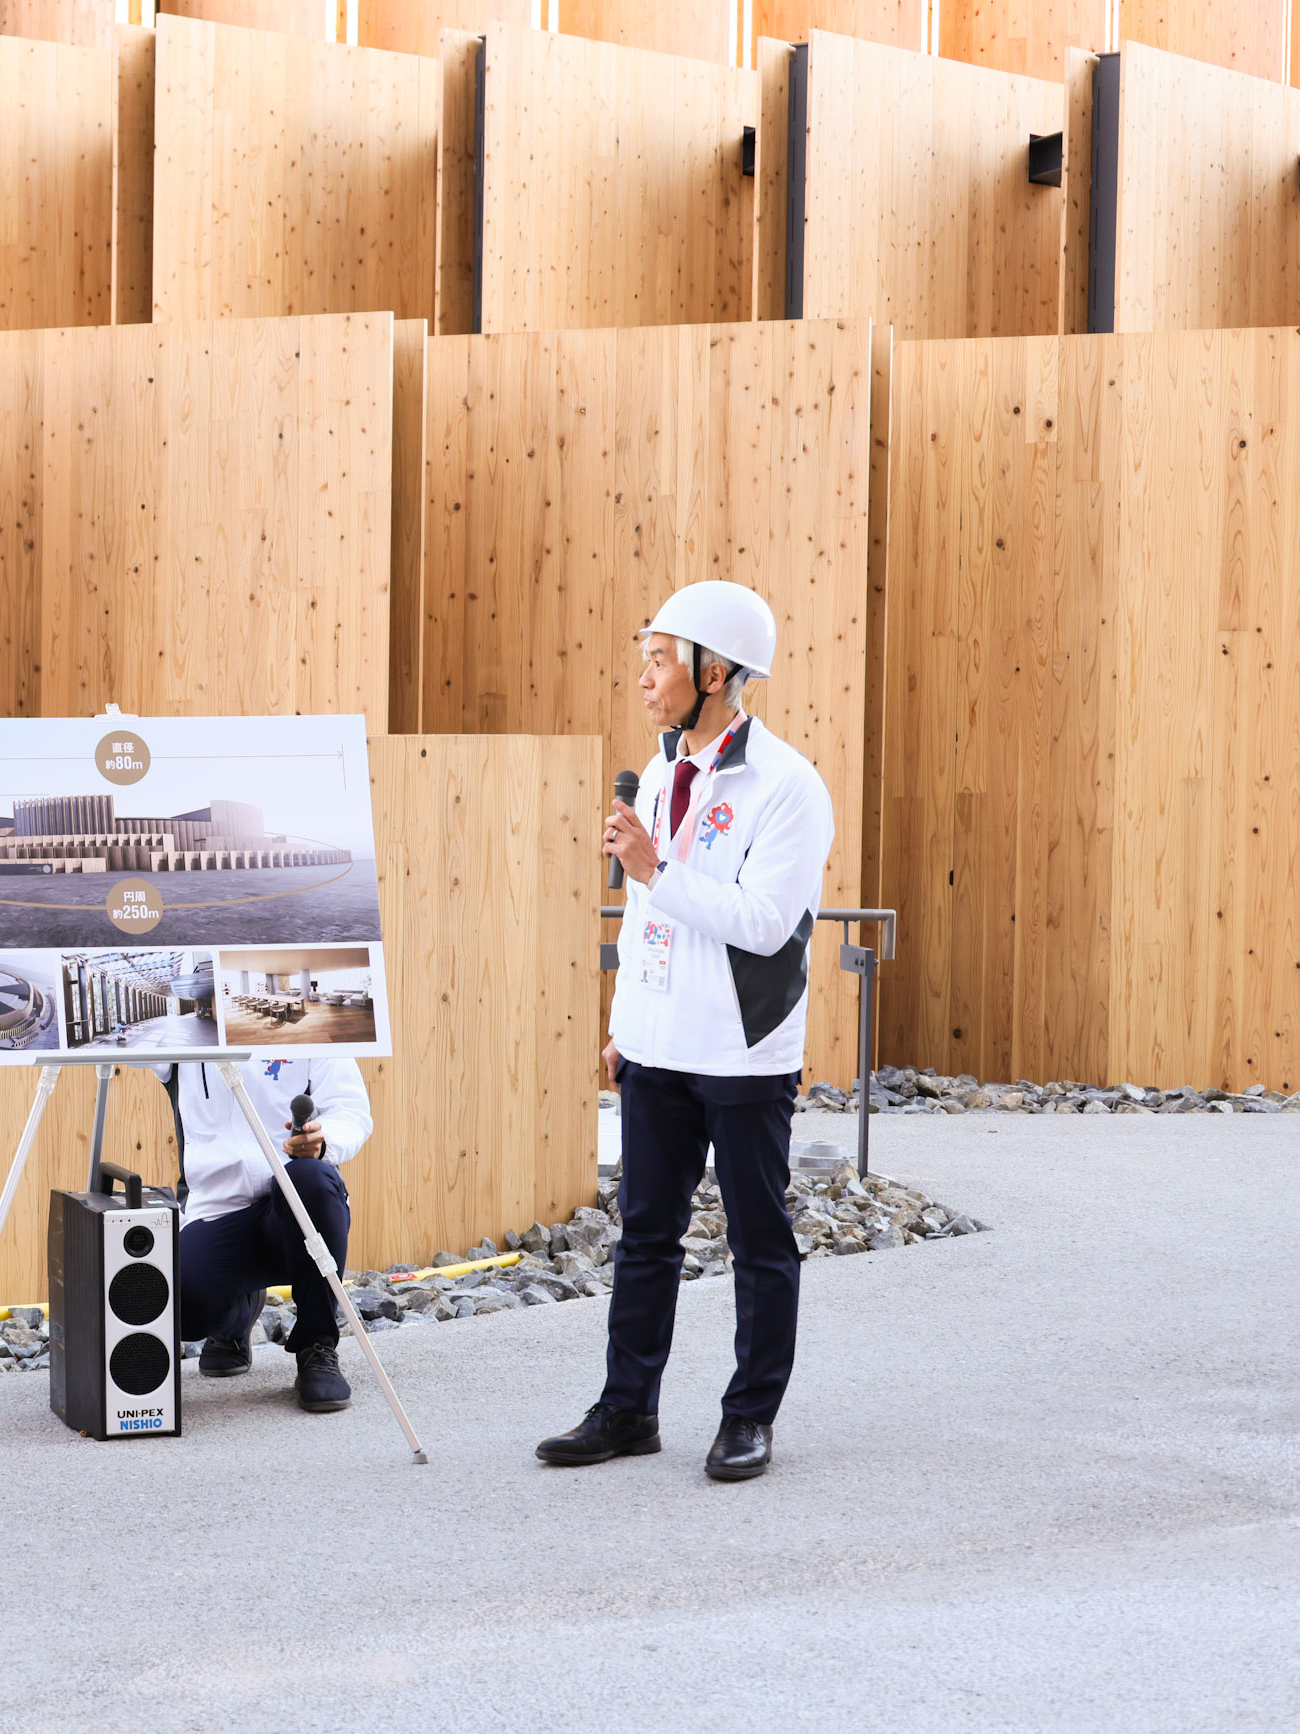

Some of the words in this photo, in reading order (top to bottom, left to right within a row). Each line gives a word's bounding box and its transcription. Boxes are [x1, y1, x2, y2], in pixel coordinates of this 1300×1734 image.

[112, 742, 135, 753] 直径
[105, 756, 143, 770] 約80m
[123, 891, 146, 903] 円周
[112, 905, 159, 919] 約250m
[120, 1418, 162, 1431] NISHIO
